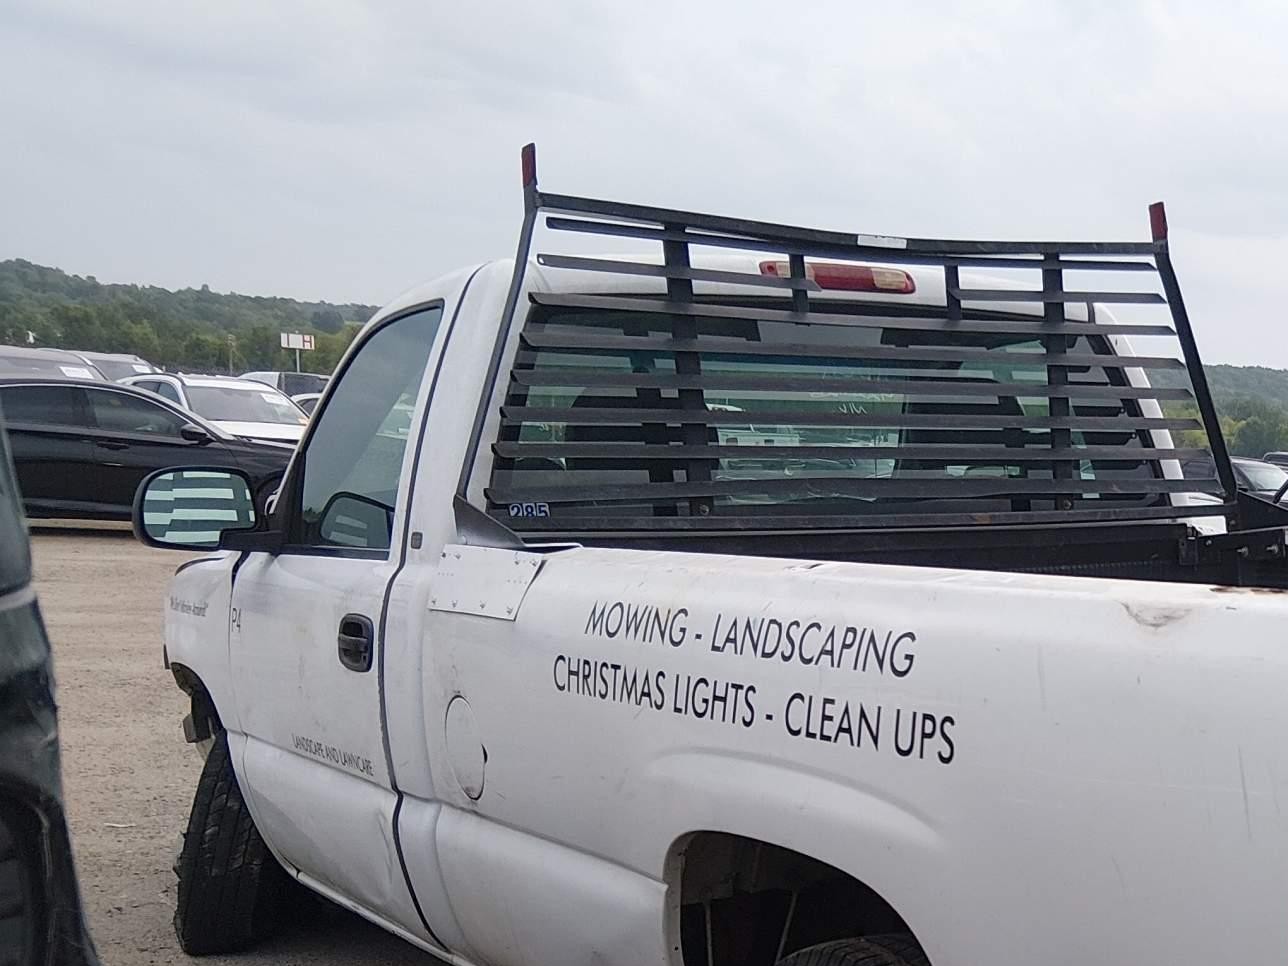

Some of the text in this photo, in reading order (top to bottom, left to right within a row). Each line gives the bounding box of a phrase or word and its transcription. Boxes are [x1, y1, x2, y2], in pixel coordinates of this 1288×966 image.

[510, 503, 550, 517] 285
[231, 607, 241, 633] P4
[585, 600, 689, 647] MOWING
[711, 613, 917, 678] LANDSCAPING
[553, 655, 666, 711] CHRISTMAS
[673, 674, 757, 727] LIGHTS
[785, 692, 882, 751] CLEAN
[895, 708, 955, 764] UPS
